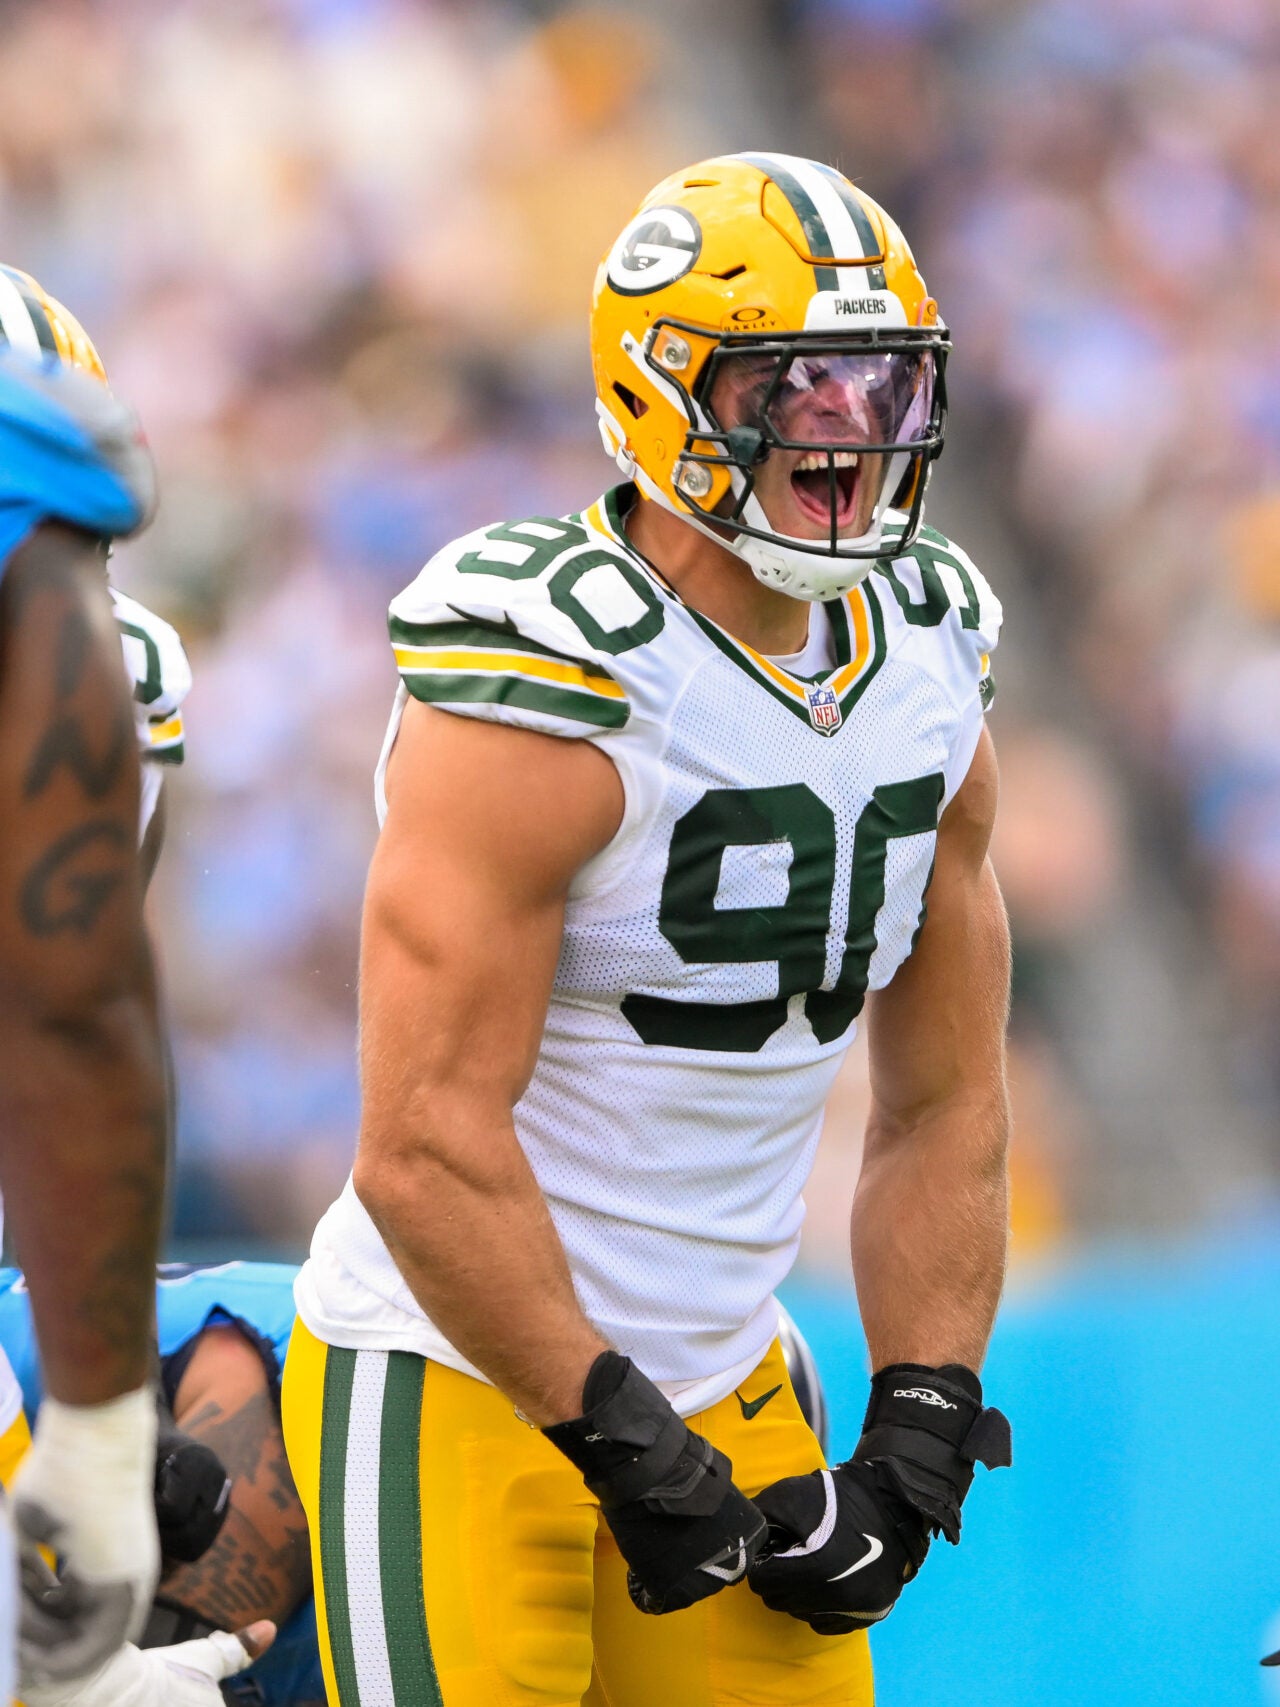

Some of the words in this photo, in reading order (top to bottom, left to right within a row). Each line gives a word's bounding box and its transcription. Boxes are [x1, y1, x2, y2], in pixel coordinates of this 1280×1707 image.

[834, 298, 886, 315] PACKERS
[455, 515, 665, 656] 90
[814, 705, 838, 727] NFL
[620, 771, 946, 1053] 90
